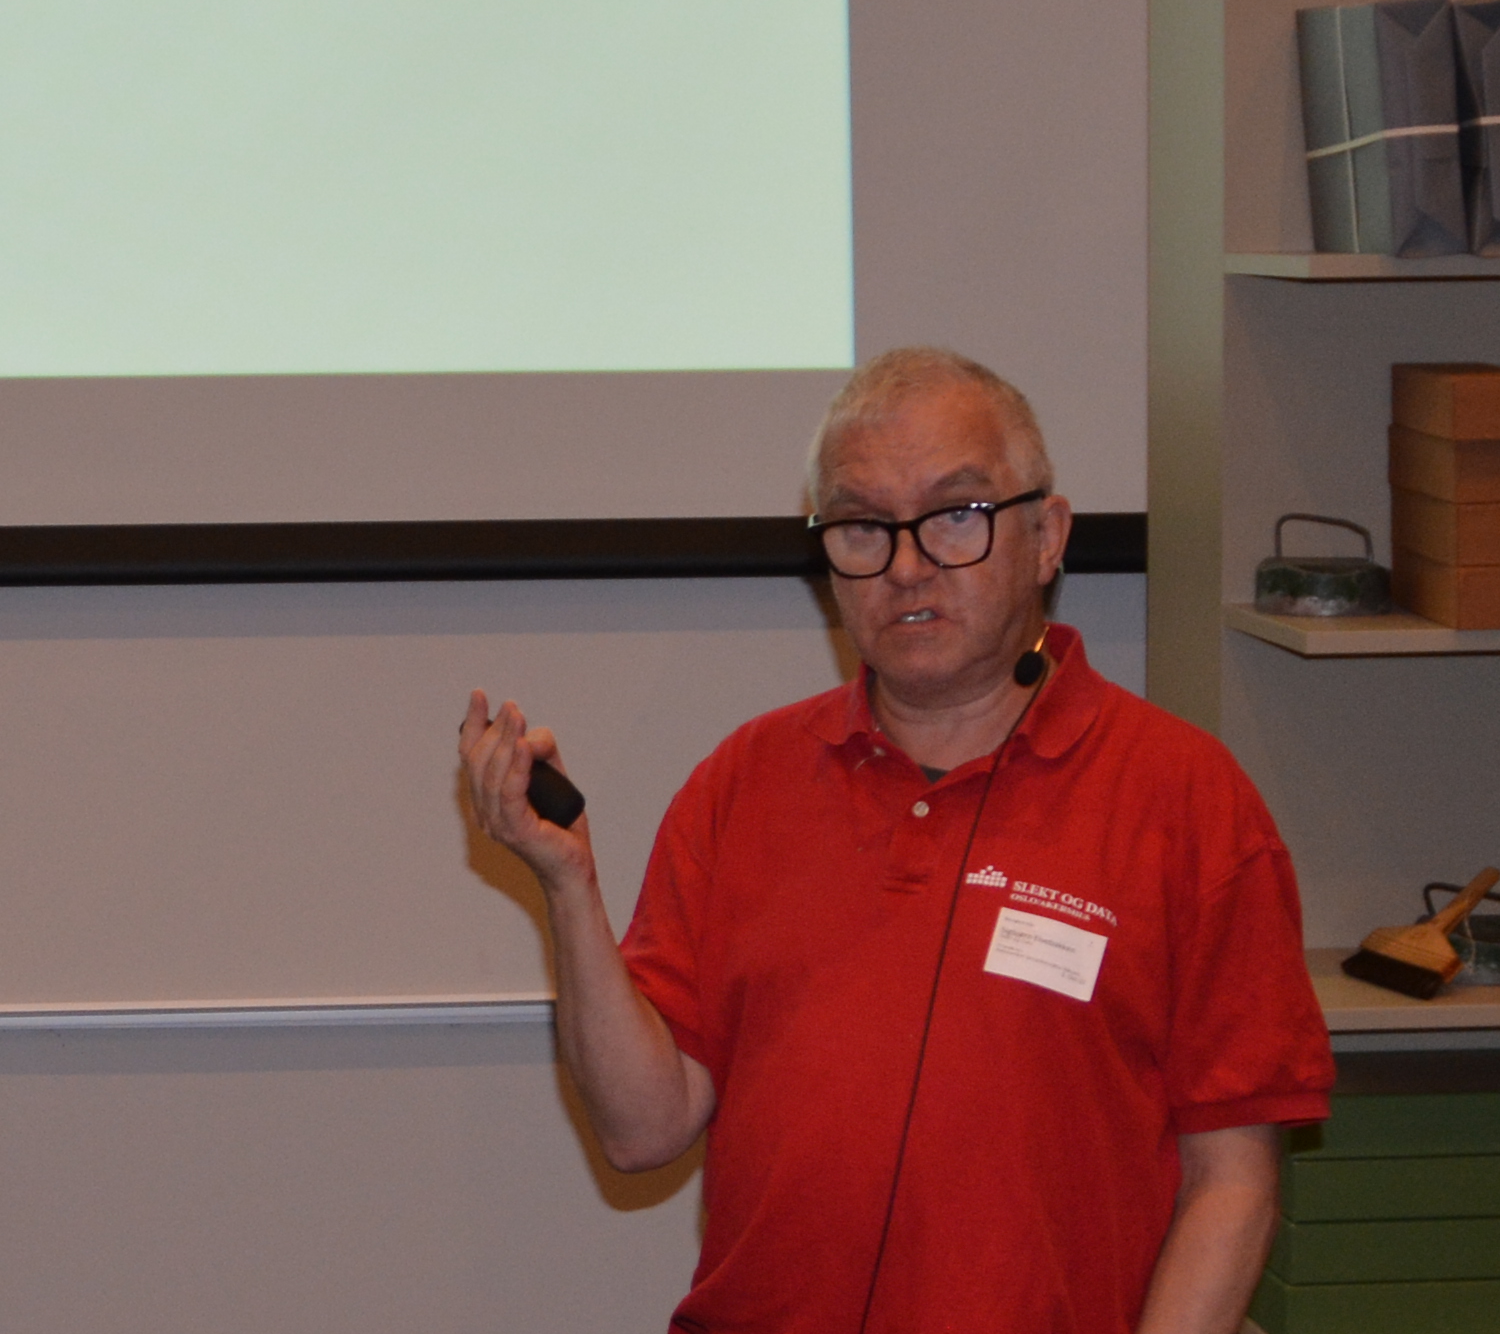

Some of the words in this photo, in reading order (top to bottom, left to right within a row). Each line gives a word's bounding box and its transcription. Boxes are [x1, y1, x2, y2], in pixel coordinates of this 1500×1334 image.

[1012, 880, 1060, 901] SLEKT
[1061, 892, 1084, 909] OG
[1085, 902, 1118, 927] DATA
